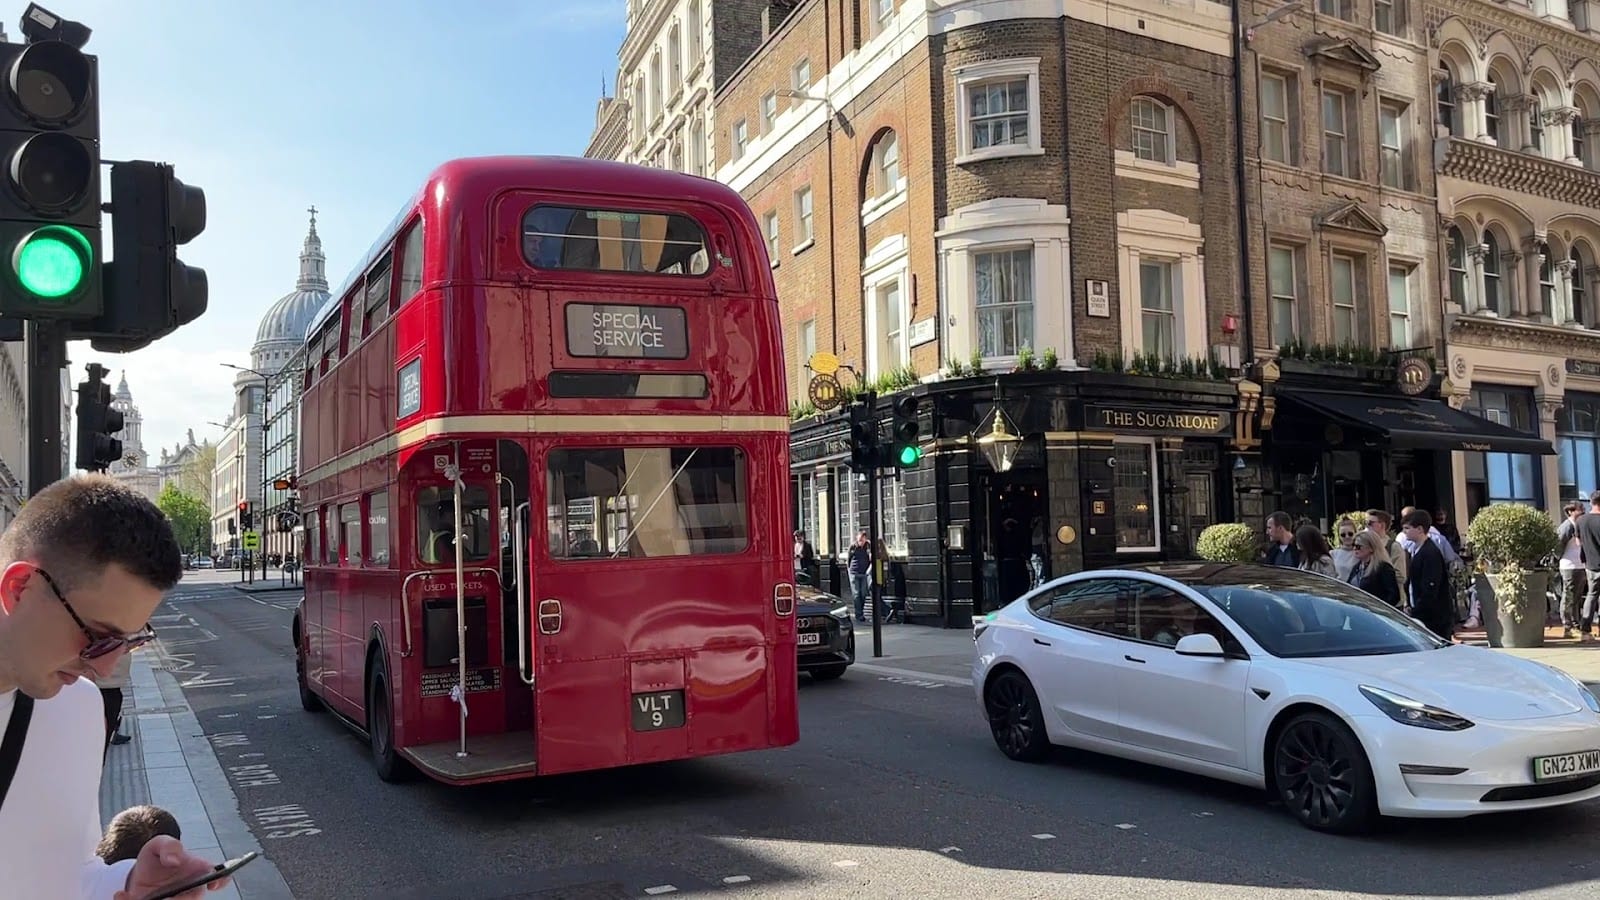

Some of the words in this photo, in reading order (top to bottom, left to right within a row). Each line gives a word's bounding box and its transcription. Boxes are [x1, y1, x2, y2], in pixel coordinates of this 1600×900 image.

[592, 311, 663, 330] SPECIAL
[593, 329, 665, 348] SERVICE
[424, 584, 446, 592] USED
[449, 581, 483, 590] TIKETS
[638, 695, 671, 712] VLT
[652, 711, 663, 727] 9
[1542, 756, 1576, 775] GN23
